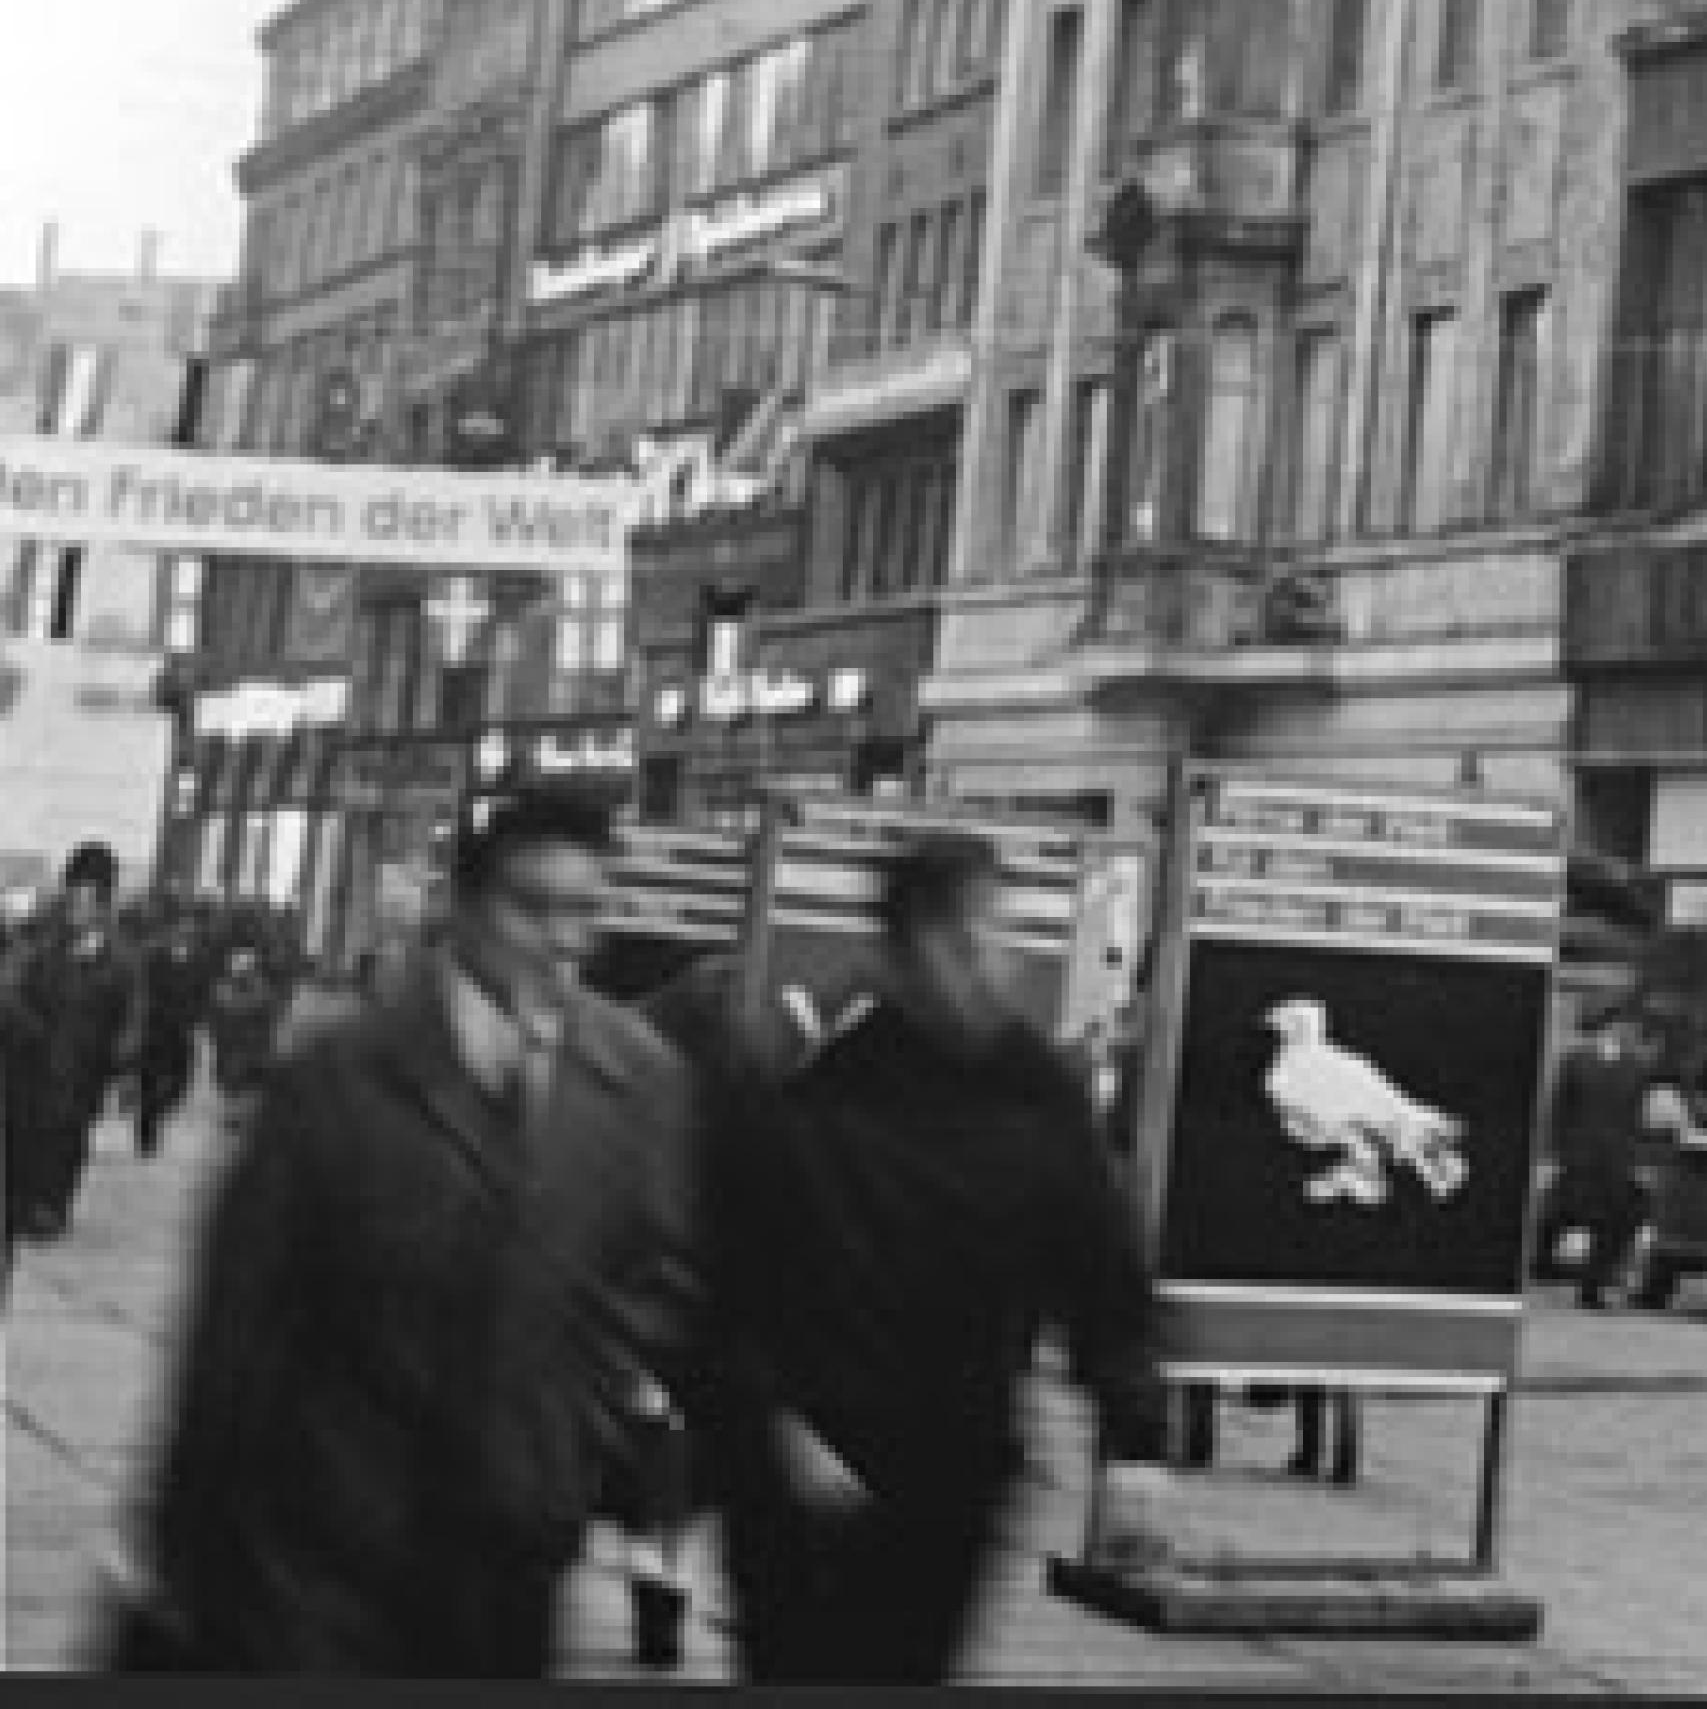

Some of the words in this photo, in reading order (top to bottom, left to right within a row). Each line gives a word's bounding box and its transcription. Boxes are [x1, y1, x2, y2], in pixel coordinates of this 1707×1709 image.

[109, 460, 345, 537] Frieden
[361, 490, 466, 543] der
[486, 494, 615, 550] Welt
